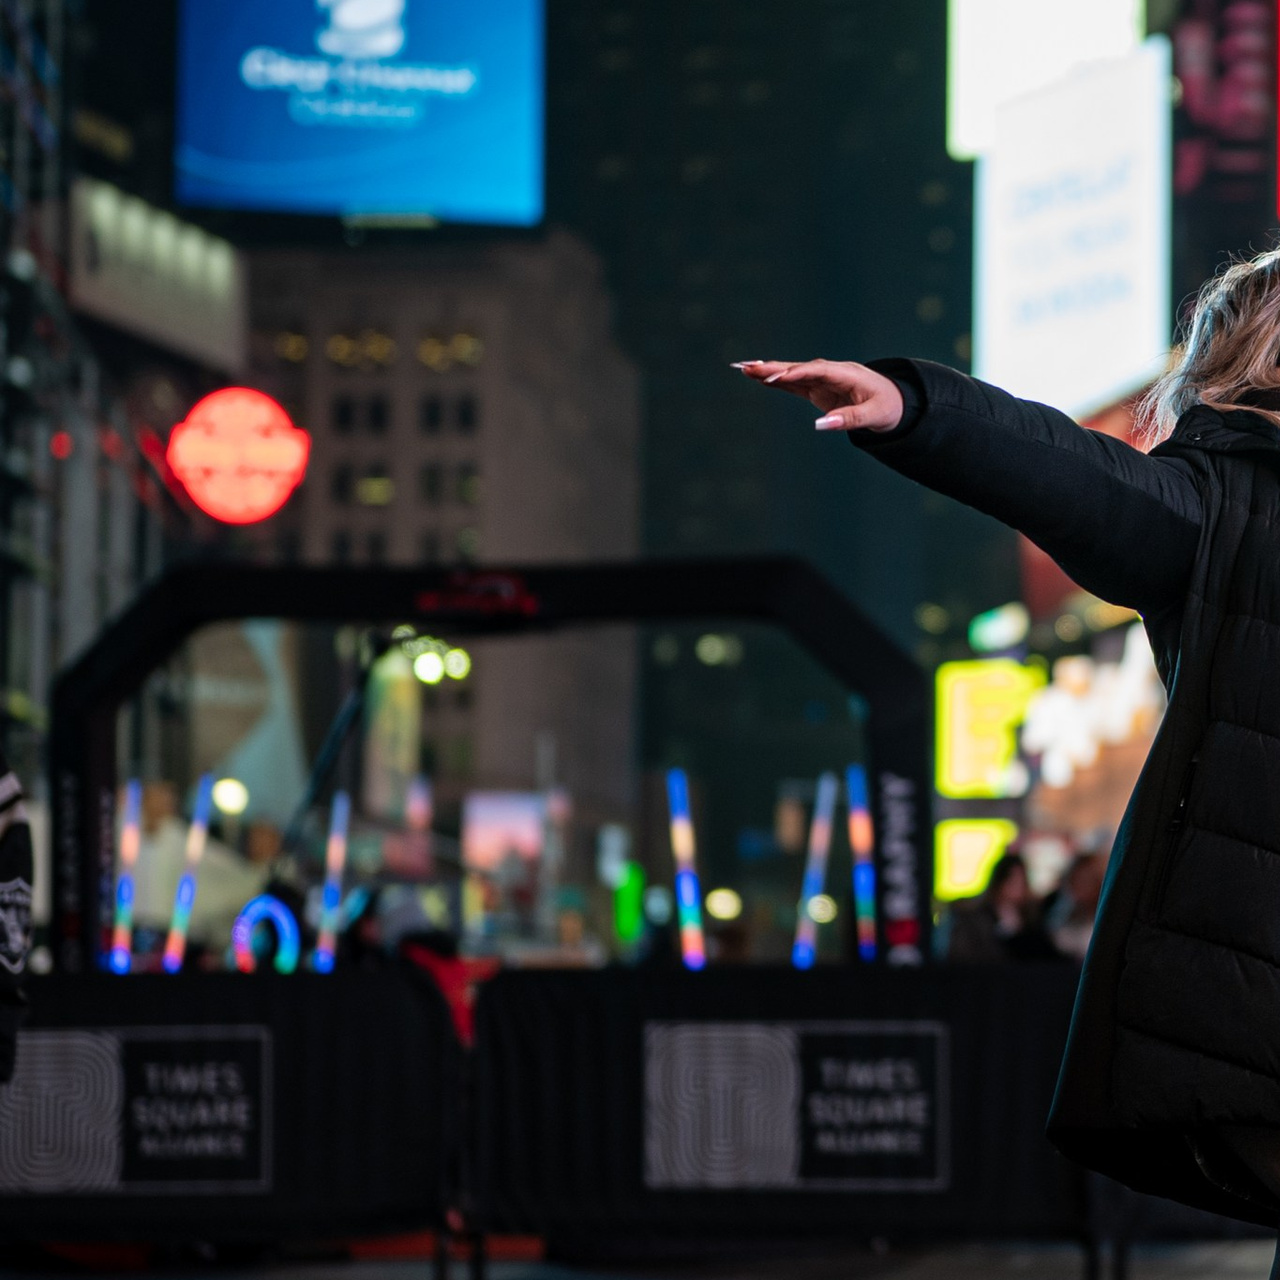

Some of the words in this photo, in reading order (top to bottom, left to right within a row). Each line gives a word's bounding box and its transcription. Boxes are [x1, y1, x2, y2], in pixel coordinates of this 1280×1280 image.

[145, 1061, 243, 1093] TIMES
[820, 1058, 921, 1090] TIMES
[133, 1095, 252, 1131] SQUARE
[808, 1092, 930, 1126] SQUARE
